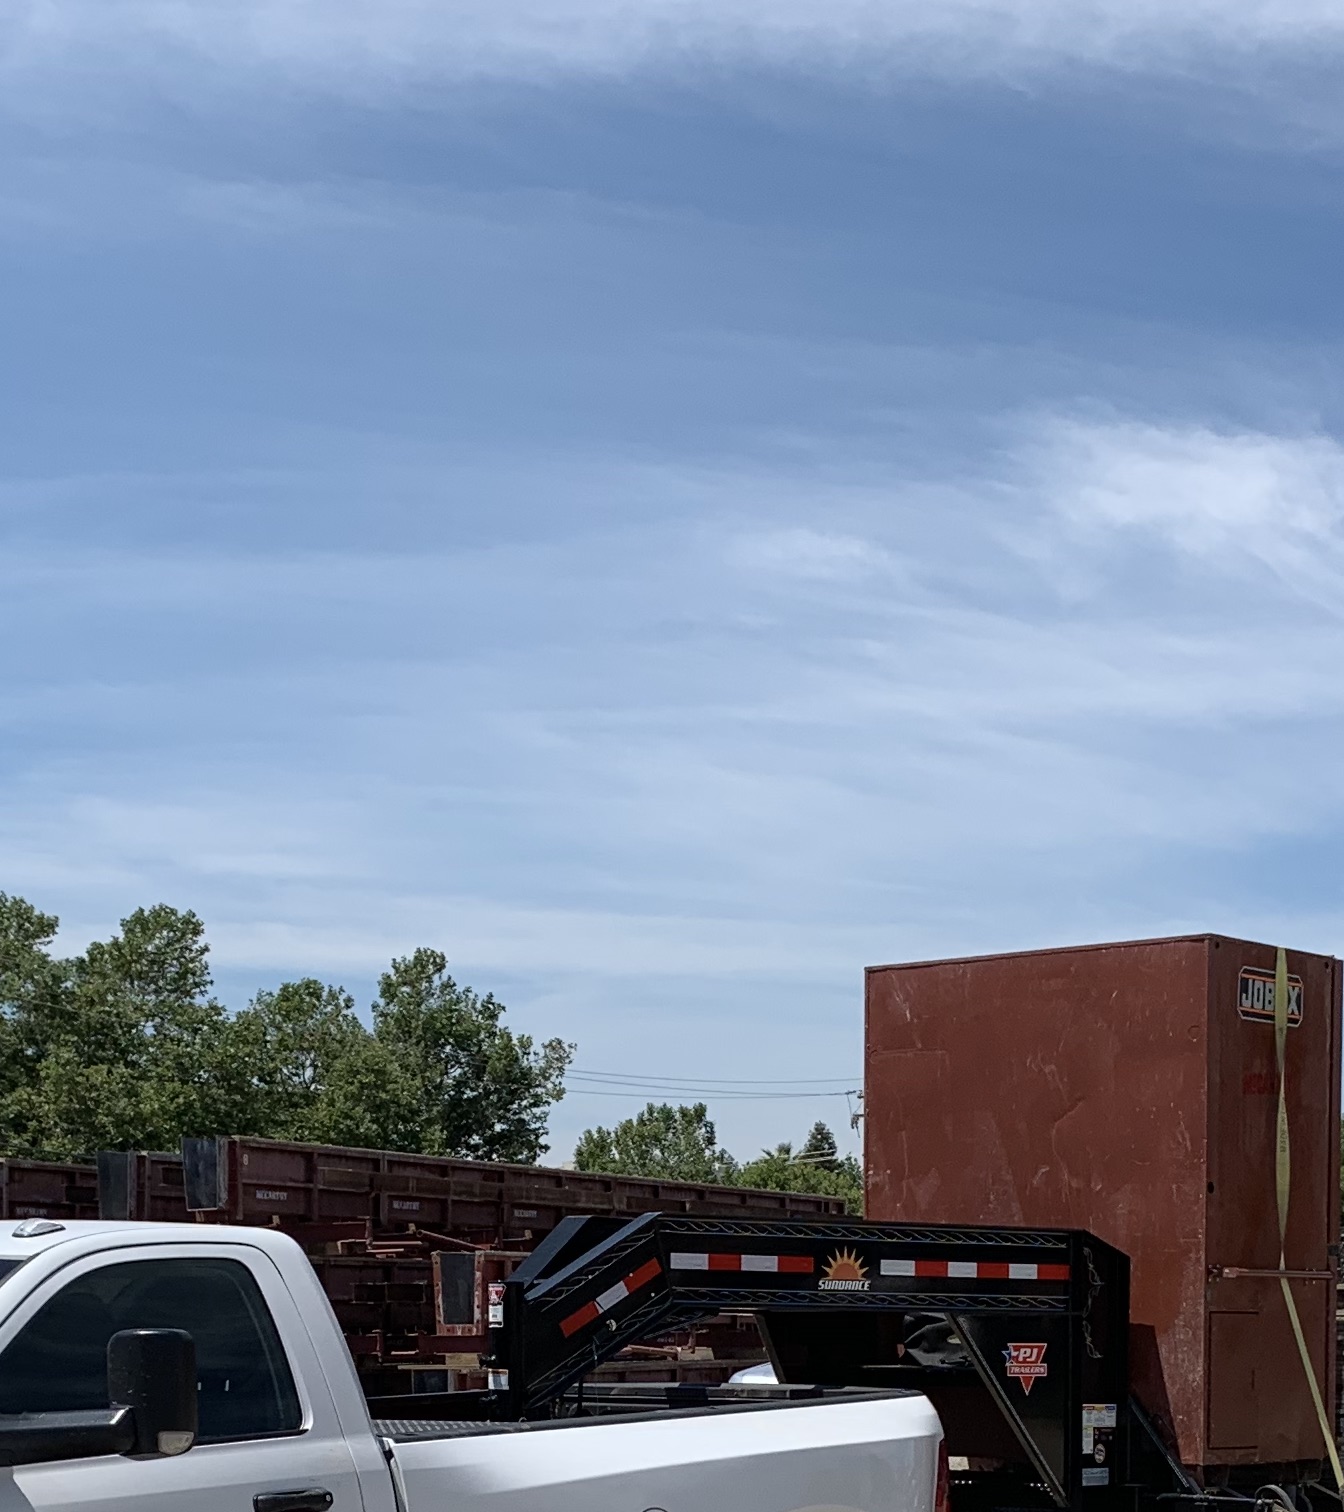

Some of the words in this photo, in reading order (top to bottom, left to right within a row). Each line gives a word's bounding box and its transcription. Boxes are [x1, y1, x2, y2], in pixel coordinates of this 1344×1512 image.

[1241, 978, 1300, 1015] JOBX
[818, 1280, 871, 1291] SUNDANCE
[1018, 1348, 1039, 1362] PJ
[1010, 1366, 1045, 1374] TRAILERS
